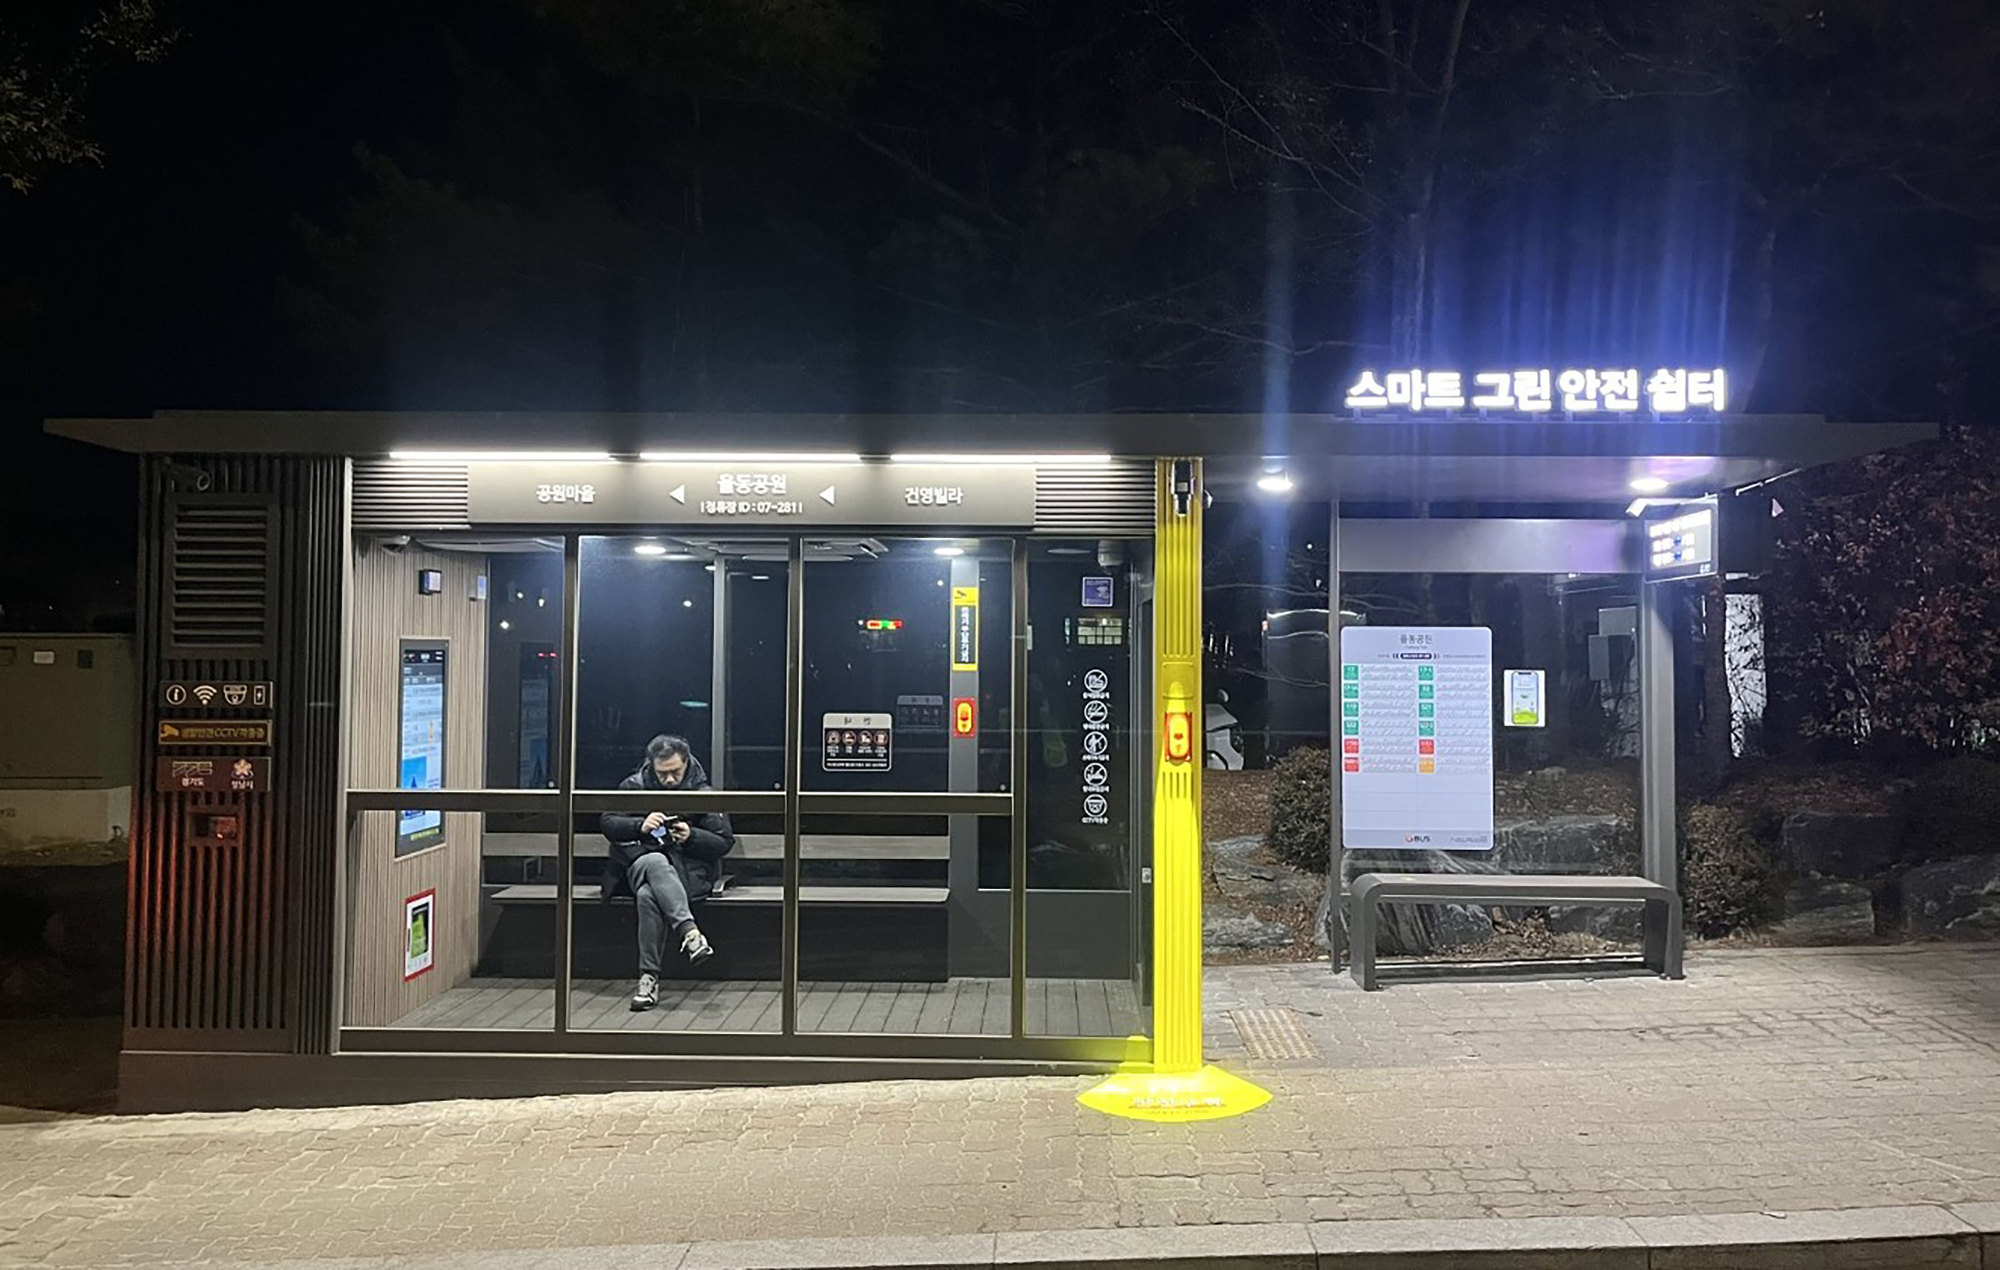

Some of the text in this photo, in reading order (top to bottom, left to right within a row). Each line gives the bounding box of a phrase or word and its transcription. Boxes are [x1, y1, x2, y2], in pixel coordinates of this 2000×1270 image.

[1346, 368, 1724, 410] 스마트 그린 안전 쉼터
[536, 484, 596, 502] 공원마을
[717, 473, 786, 494] 율동공원
[905, 486, 963, 504] 건영빌라
